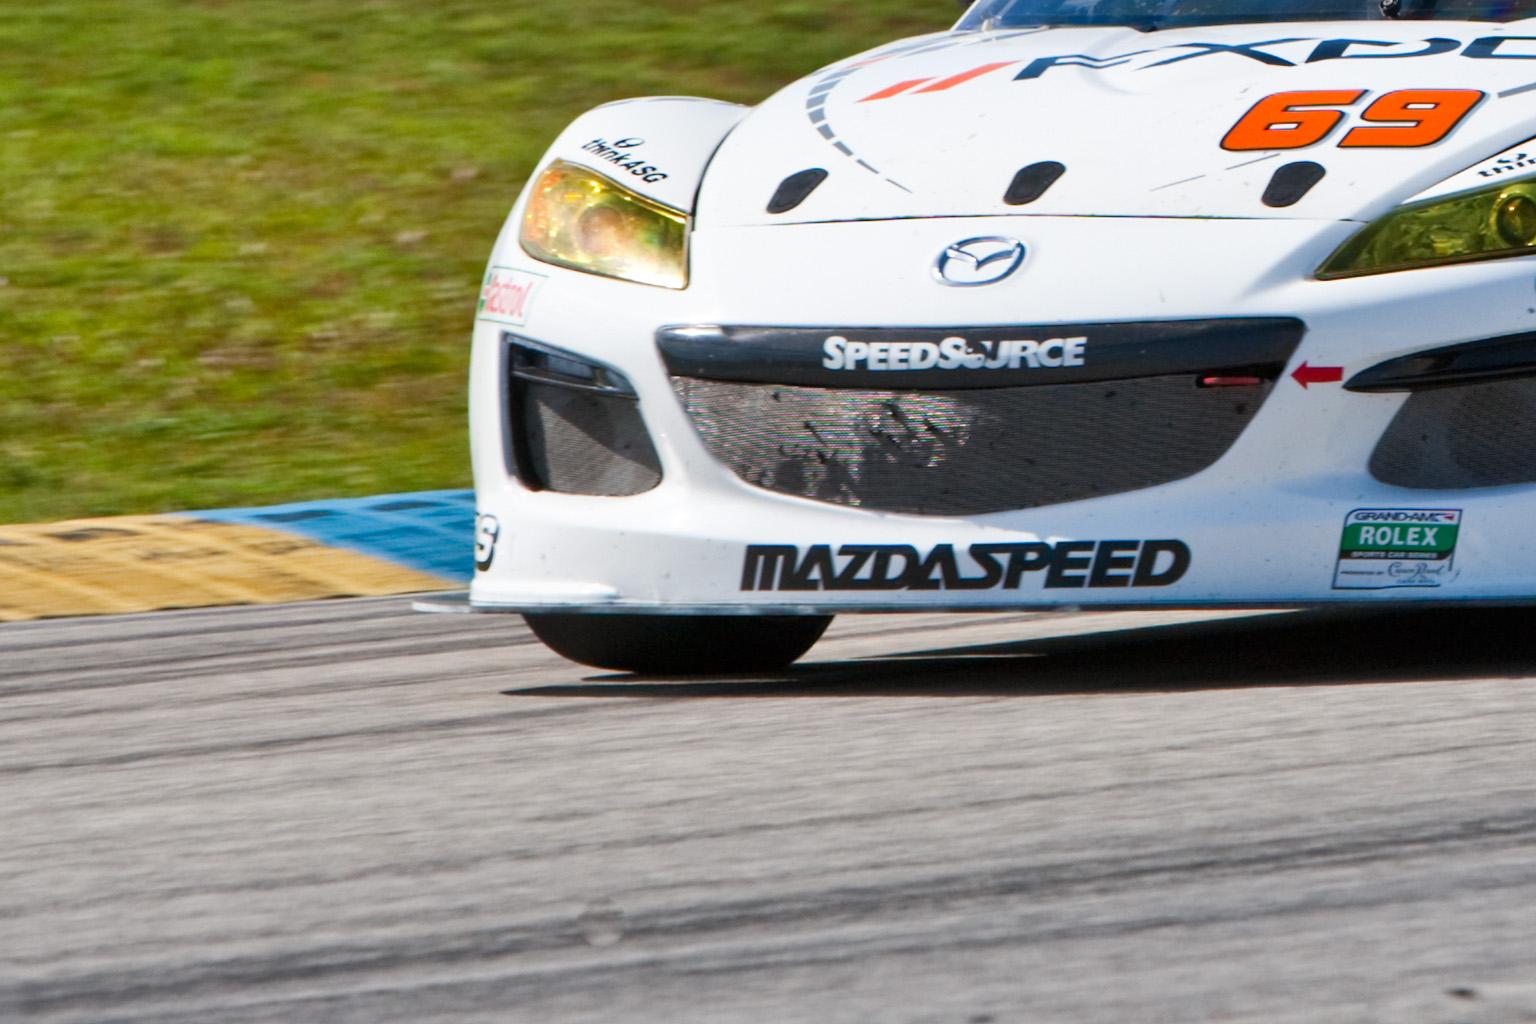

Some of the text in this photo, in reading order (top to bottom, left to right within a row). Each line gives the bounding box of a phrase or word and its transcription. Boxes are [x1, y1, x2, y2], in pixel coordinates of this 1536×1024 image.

[1219, 88, 1488, 152] 69
[1358, 526, 1439, 546] ROLEX
[740, 539, 1192, 592] MAZDASPEED
